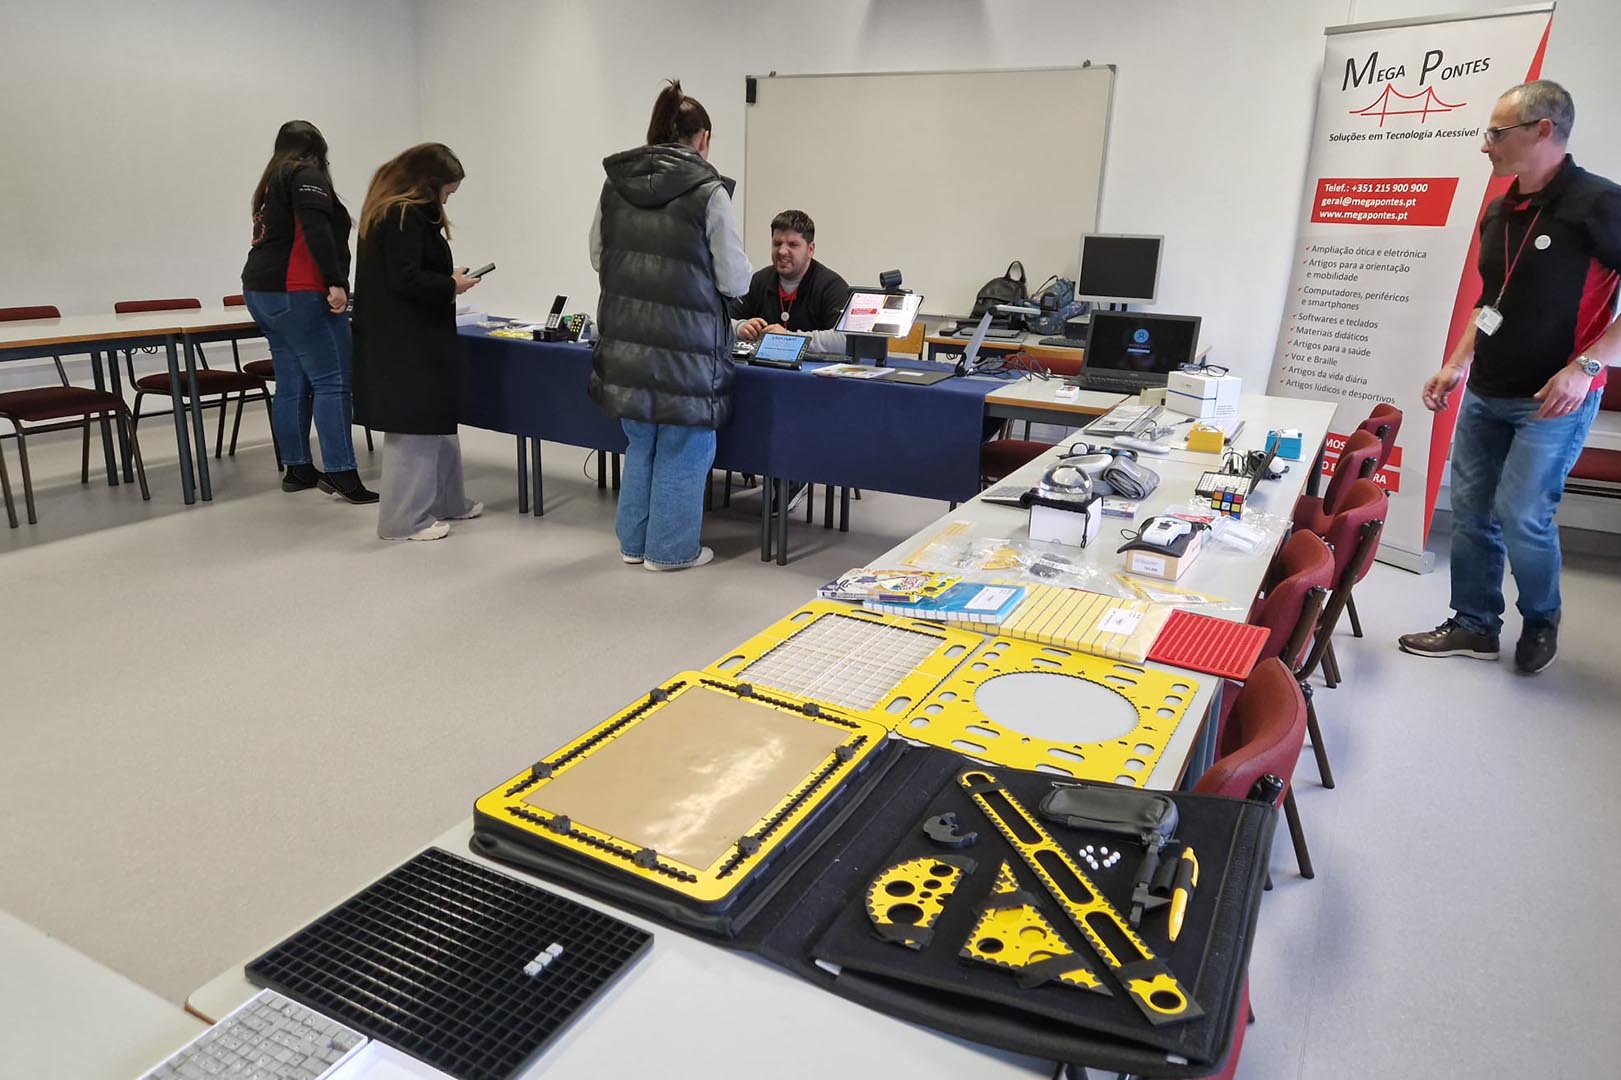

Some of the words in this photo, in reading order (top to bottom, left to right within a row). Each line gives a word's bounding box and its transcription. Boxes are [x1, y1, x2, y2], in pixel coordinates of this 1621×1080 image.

[1342, 52, 1405, 91] MEGA
[1419, 49, 1490, 86] PONTES
[1329, 132, 1366, 142] Soluções
[1386, 129, 1433, 140] Tecnologia
[1435, 128, 1479, 138] Acessível
[1352, 184, 1373, 192] +351
[1375, 184, 1390, 192] 215
[1392, 184, 1408, 192] 900
[1410, 184, 1428, 192] 900
[1322, 197, 1416, 207] geral@megapontes.pt
[1320, 211, 1408, 221] www.megapontes.pt
[1312, 245, 1354, 255] Ampliação
[1356, 247, 1375, 256] ótica
[1309, 259, 1337, 270] Artigos
[1339, 262, 1357, 271] para
[1366, 263, 1410, 273] orientação
[1313, 271, 1358, 281] mobilidade
[1304, 286, 1362, 299] Computadores,
[1365, 291, 1409, 303] periféricos
[1308, 299, 1359, 311] smartphones
[1298, 313, 1337, 324] Softwares
[1346, 318, 1378, 328] teclados
[1296, 327, 1332, 338] Materiais
[1335, 330, 1368, 342] didáticos
[1293, 340, 1321, 351] Artigos
[1323, 344, 1339, 354] para
[1348, 346, 1371, 356] saúde
[1291, 353, 1305, 361] Voz
[1314, 356, 1338, 366] Braille
[1289, 366, 1315, 377] Artigos
[1317, 370, 1326, 378] da
[1329, 371, 1343, 381] vida
[1345, 374, 1367, 384] diária
[1286, 379, 1312, 390] Artigos
[1315, 383, 1340, 395] lúdicos
[1349, 391, 1395, 404] desportivos
[1326, 438, 1346, 450] MOS
[1373, 473, 1386, 484] RA
